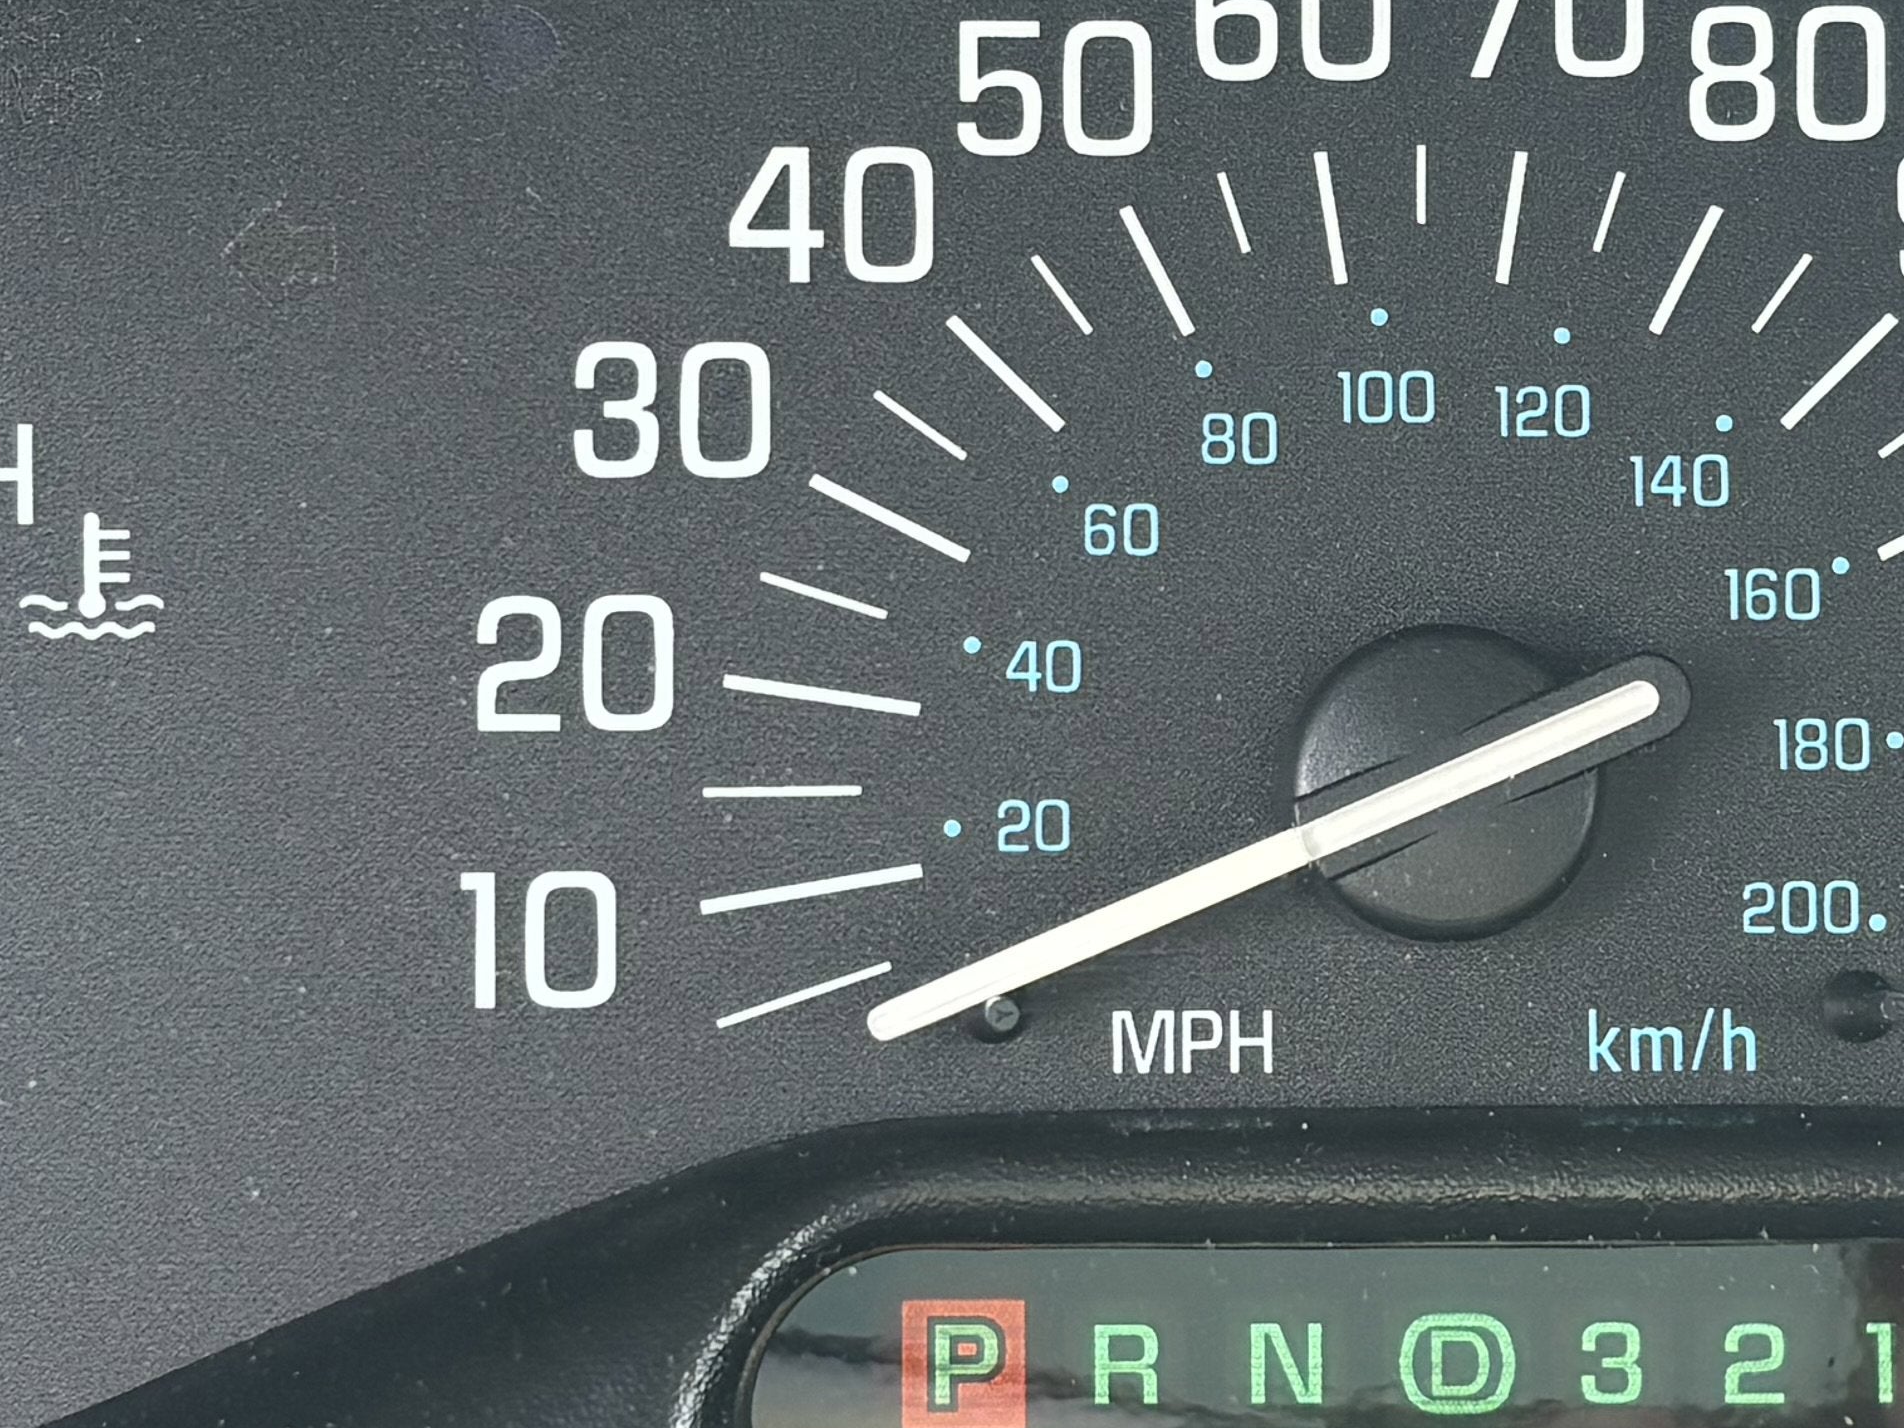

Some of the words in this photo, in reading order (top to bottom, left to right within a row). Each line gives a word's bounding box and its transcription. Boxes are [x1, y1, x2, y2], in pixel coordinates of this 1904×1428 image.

[957, 20, 1152, 156] 50
[1689, 6, 1886, 141] 80
[729, 147, 933, 282] 40
[574, 342, 770, 478] 30
[1338, 370, 1435, 423] 100
[1495, 385, 1590, 437] 120
[1201, 412, 1277, 465] 80
[1630, 454, 1729, 507] 140
[1084, 503, 1158, 556] 60
[1725, 568, 1820, 620] 160
[477, 595, 674, 731] 20
[1006, 640, 1081, 693] 40
[1774, 718, 1870, 771] 180
[998, 799, 1070, 852] 20
[1743, 880, 1859, 934] 200
[460, 871, 616, 1009] 10
[1112, 1010, 1272, 1074] MPH
[1589, 1008, 1756, 1072] km/h
[1094, 1324, 1158, 1404] R
[1250, 1323, 1322, 1403] N
[1581, 1322, 1642, 1403] 3
[1724, 1323, 1785, 1404] 2
[1866, 1323, 1893, 1403] 1
